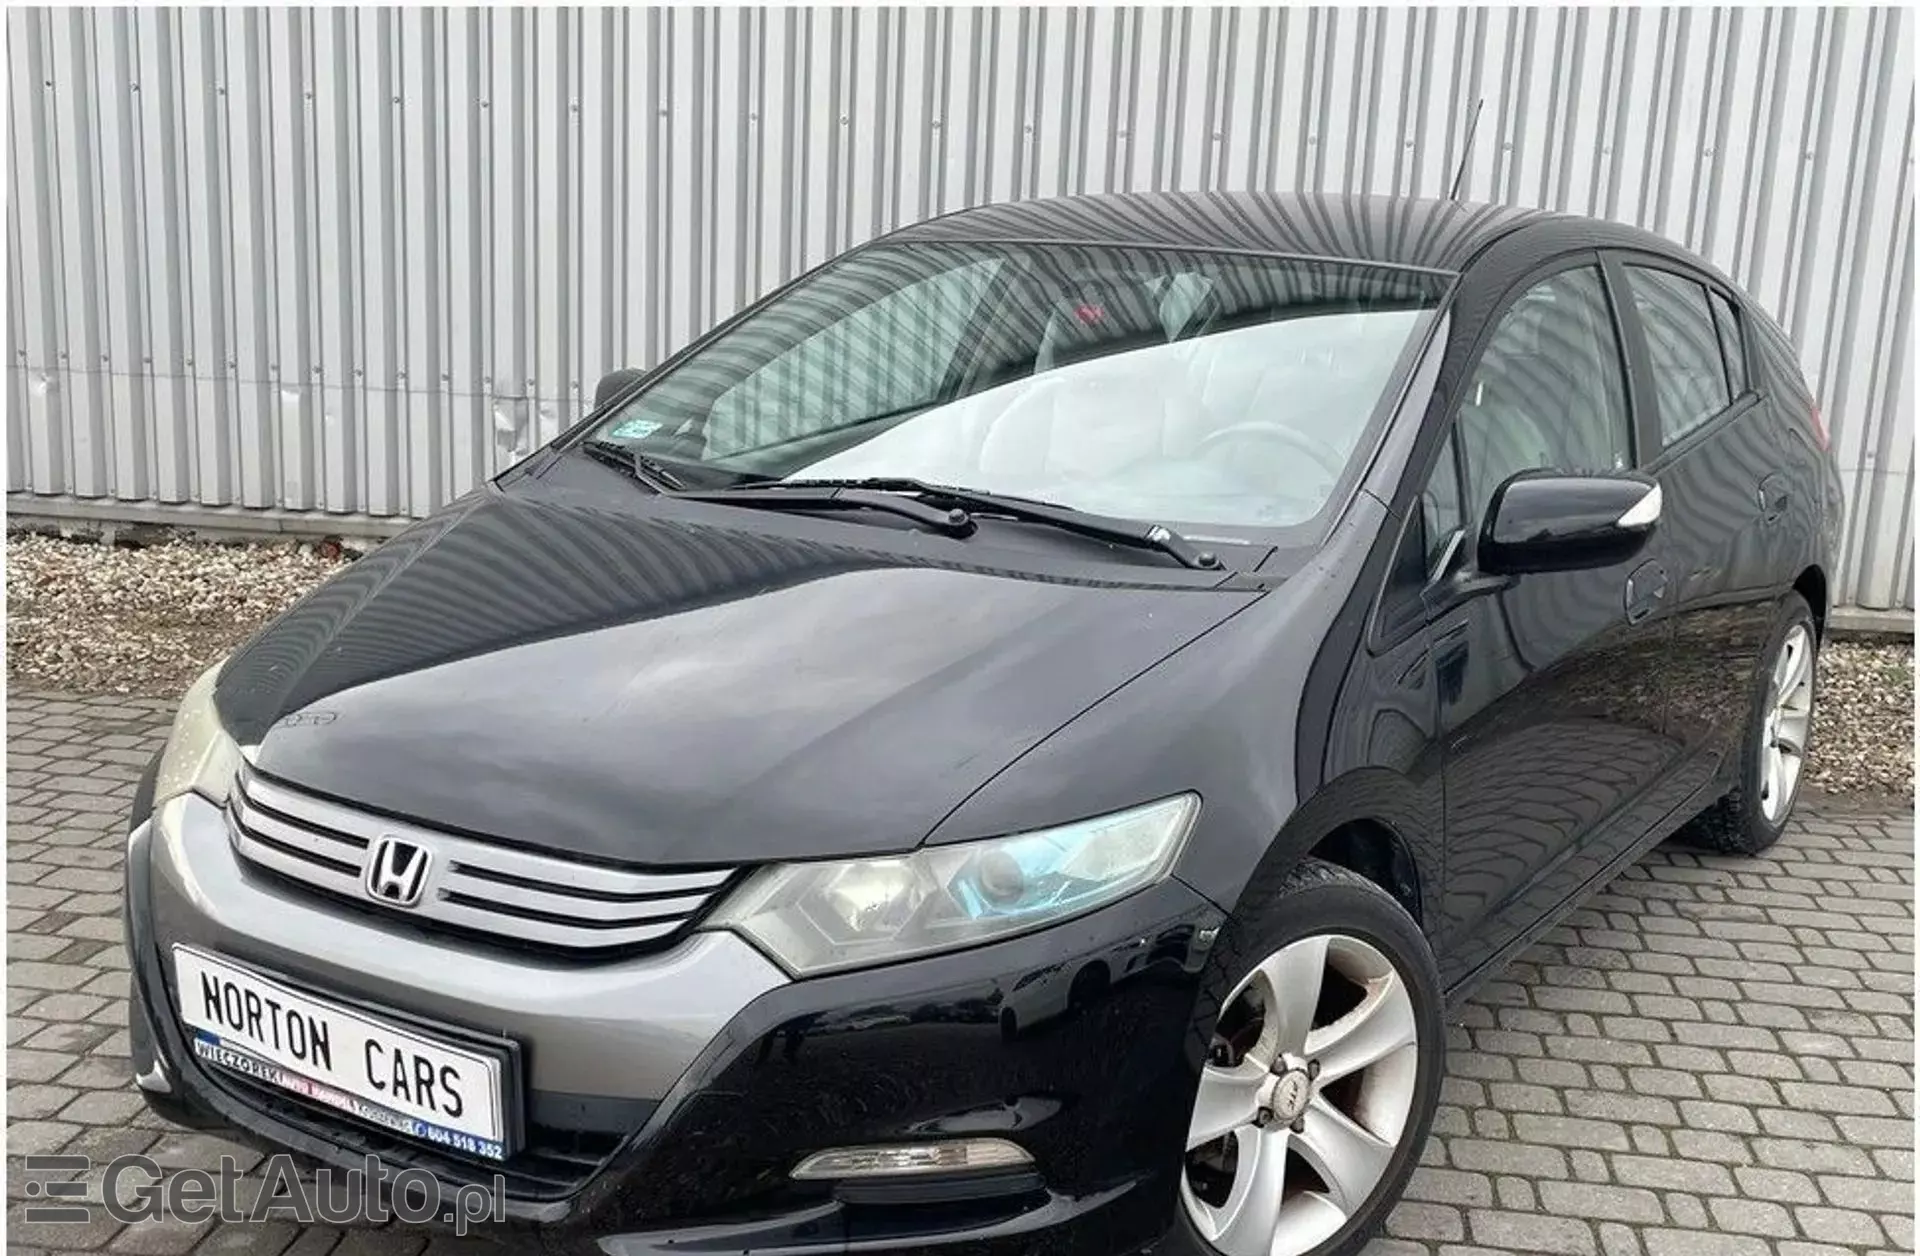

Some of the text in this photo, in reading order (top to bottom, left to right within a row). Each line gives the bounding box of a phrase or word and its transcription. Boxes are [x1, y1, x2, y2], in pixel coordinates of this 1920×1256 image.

[200, 970, 332, 1072] NORTON
[364, 1038, 464, 1118] CARS
[453, 1132, 477, 1153] 518
[478, 1140, 504, 1161] 352
